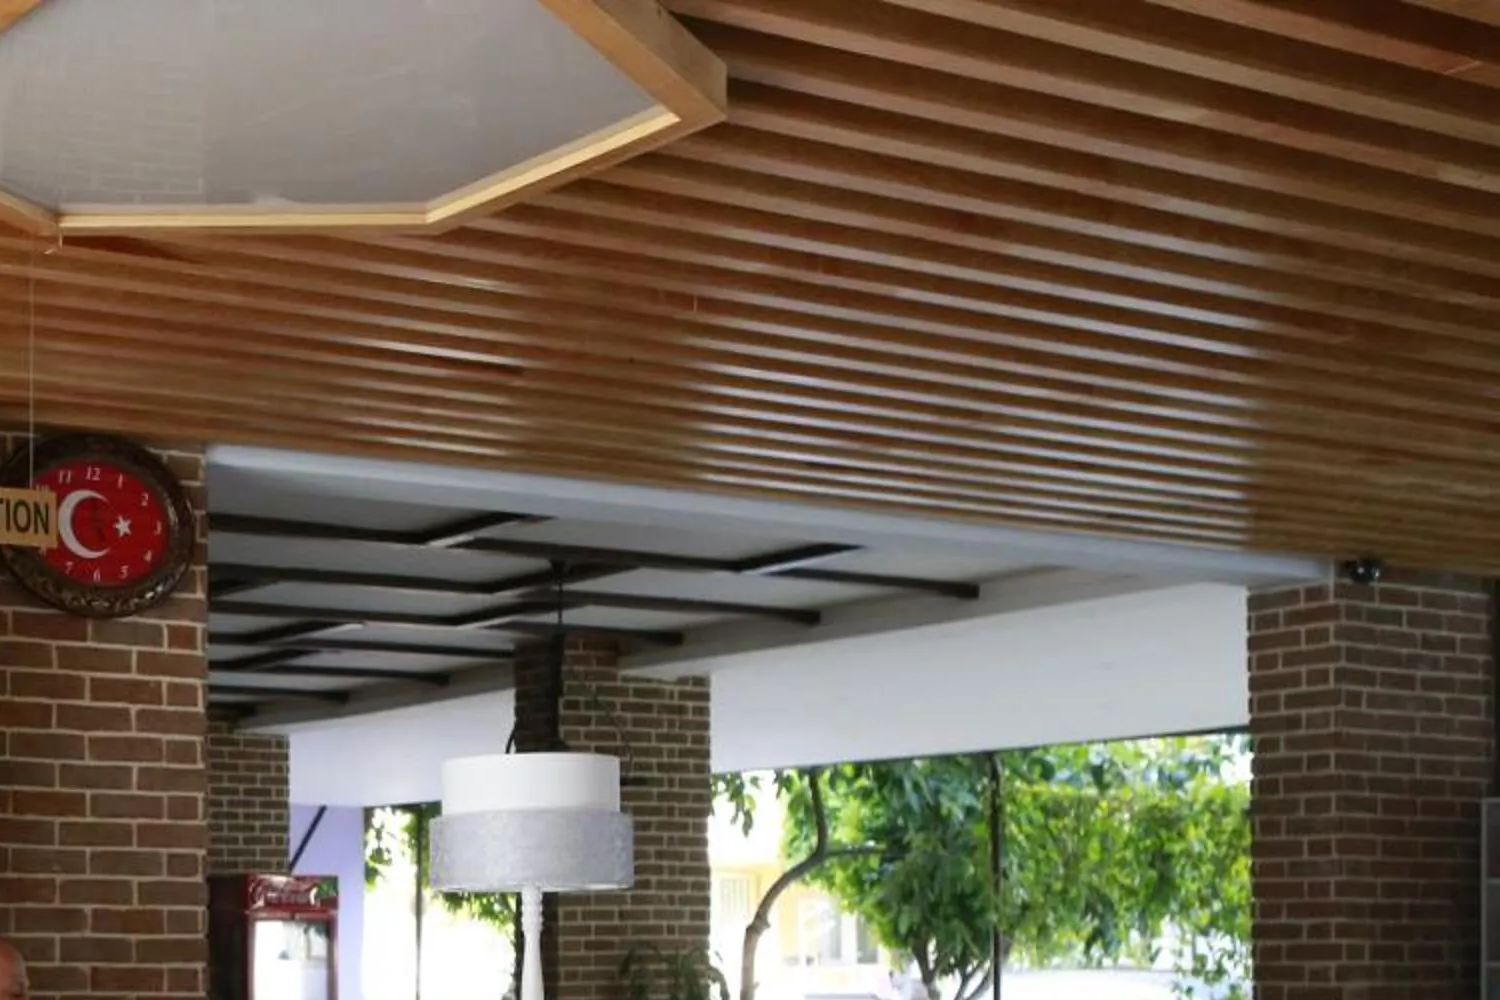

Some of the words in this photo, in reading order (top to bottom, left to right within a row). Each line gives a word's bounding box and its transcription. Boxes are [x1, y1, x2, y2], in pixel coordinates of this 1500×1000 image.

[58, 470, 72, 484] 11
[86, 465, 101, 481] 12
[117, 473, 123, 489] 1
[141, 492, 149, 507] 2
[120, 565, 130, 579] 5
